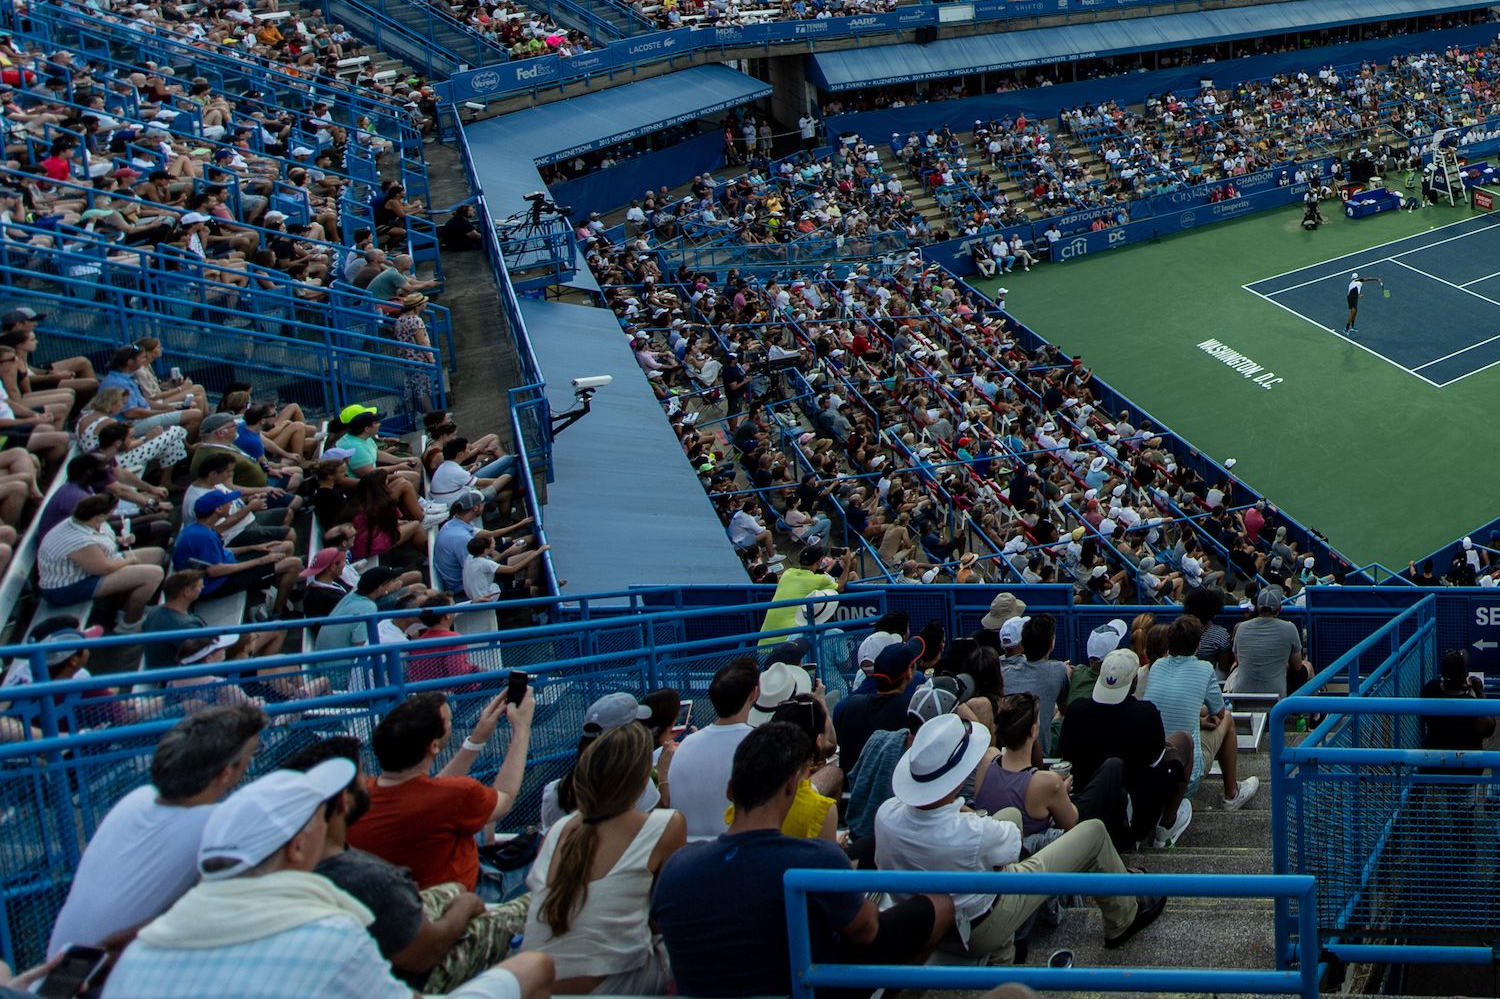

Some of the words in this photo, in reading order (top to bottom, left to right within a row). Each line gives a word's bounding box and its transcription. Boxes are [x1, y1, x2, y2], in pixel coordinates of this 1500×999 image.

[629, 40, 662, 54] LACOSTE
[516, 63, 554, 80] FedEx
[1236, 171, 1274, 186] CHANDON
[1221, 200, 1250, 212] Insperity
[1109, 229, 1126, 243] DC
[1061, 238, 1087, 258] citi
[1196, 338, 1264, 379] WASHINGTON,
[1252, 372, 1284, 390] D.C.
